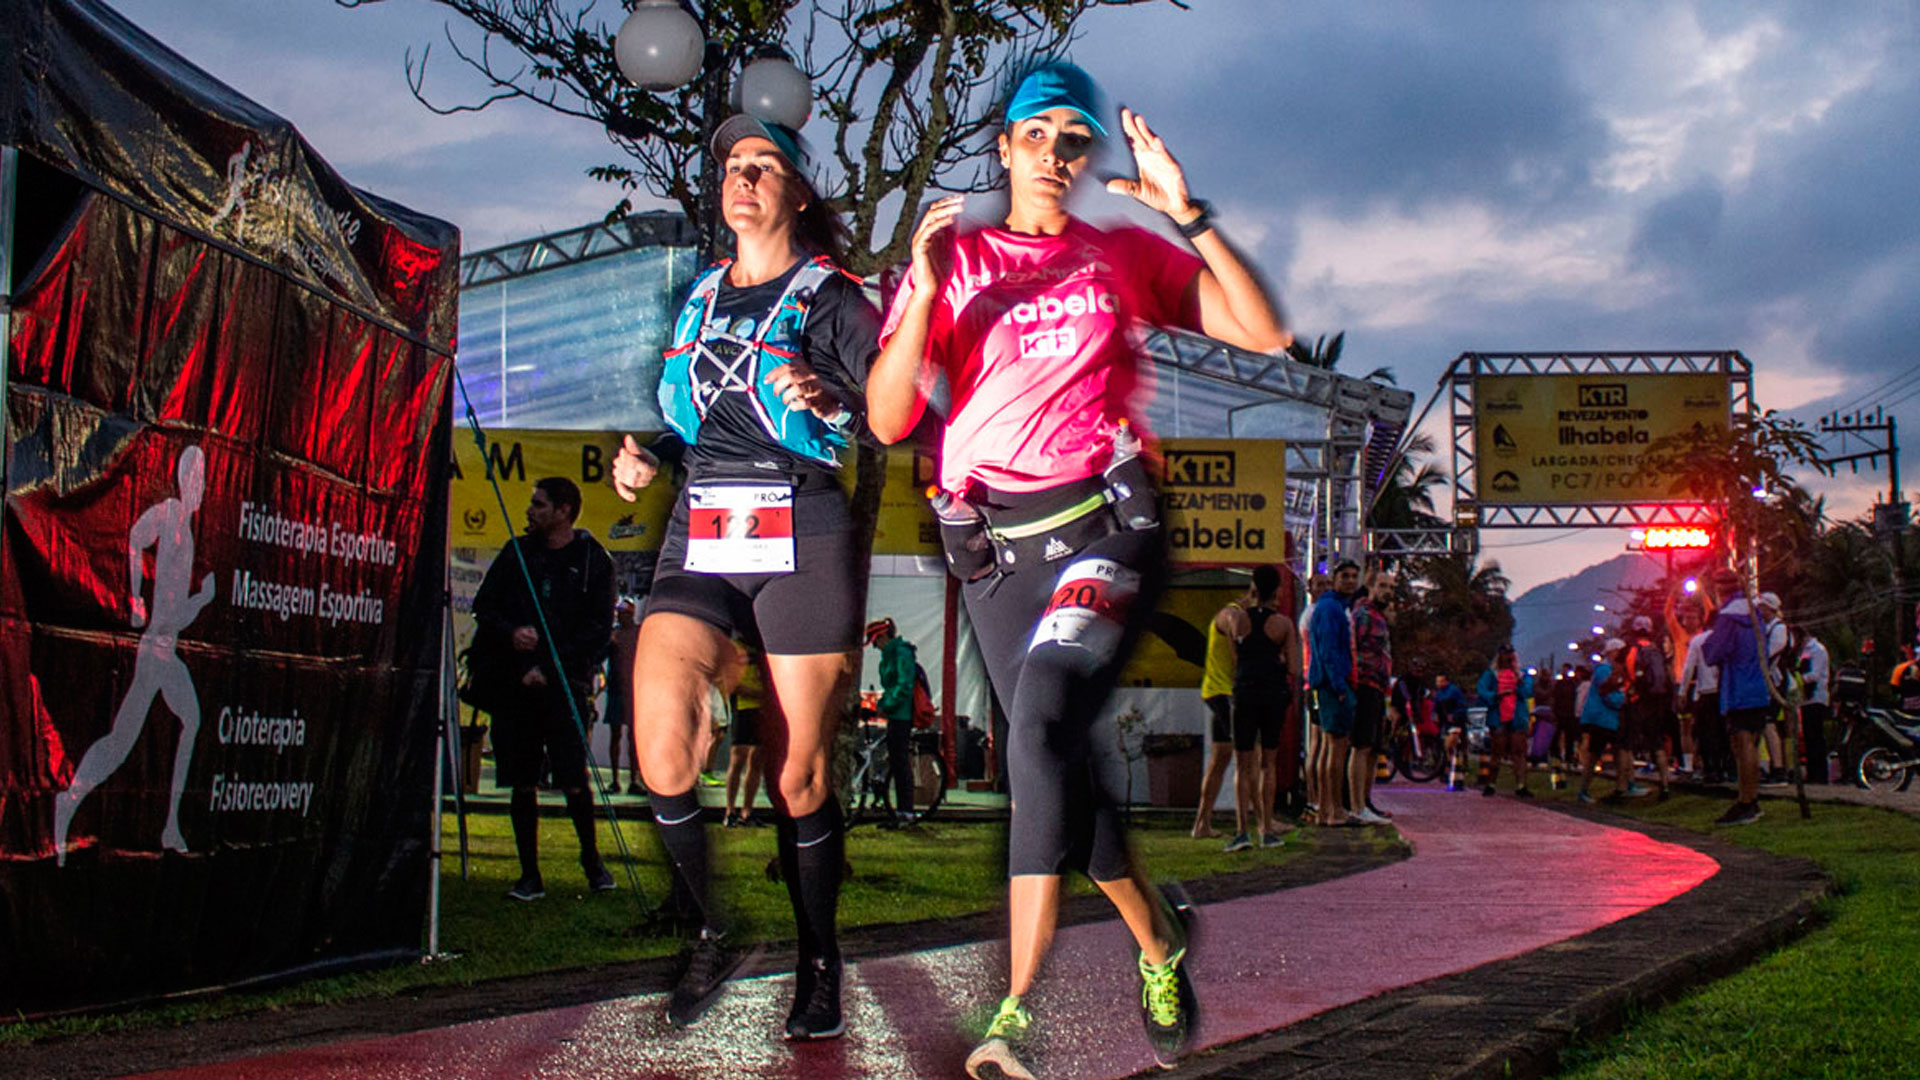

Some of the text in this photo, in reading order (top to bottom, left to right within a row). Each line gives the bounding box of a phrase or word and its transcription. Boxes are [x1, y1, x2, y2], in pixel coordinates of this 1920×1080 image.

[1580, 386, 1626, 406] KTR
[1558, 410, 1649, 422] REVEZAMENTO
[1558, 425, 1650, 446] Ilhabela
[1166, 454, 1232, 483] KTR
[1164, 492, 1267, 511] EZAMENTO
[238, 501, 397, 567] Fisioterapia Esportiva
[1171, 518, 1266, 550] abela
[231, 568, 384, 627] Massagem Esportiva
[209, 772, 314, 817] Fisiorecovery
